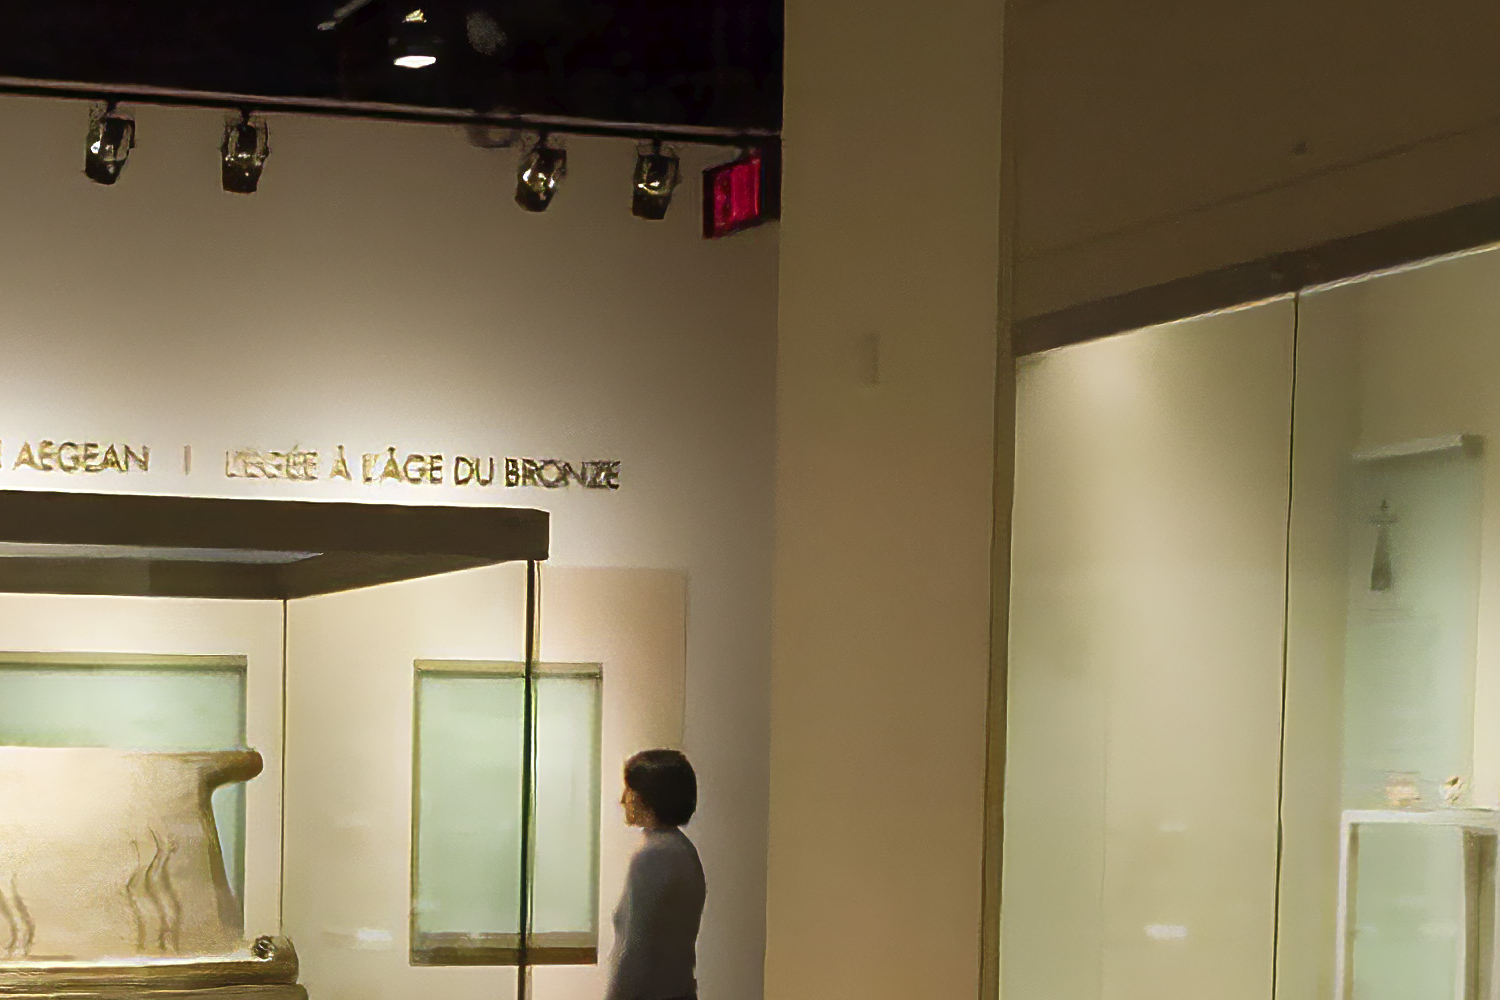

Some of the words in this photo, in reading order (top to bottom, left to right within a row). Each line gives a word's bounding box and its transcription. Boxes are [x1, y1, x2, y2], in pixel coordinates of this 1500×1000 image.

[12, 440, 149, 472] AEGEAN
[454, 456, 494, 486] DU
[505, 457, 621, 488] BRONZE
